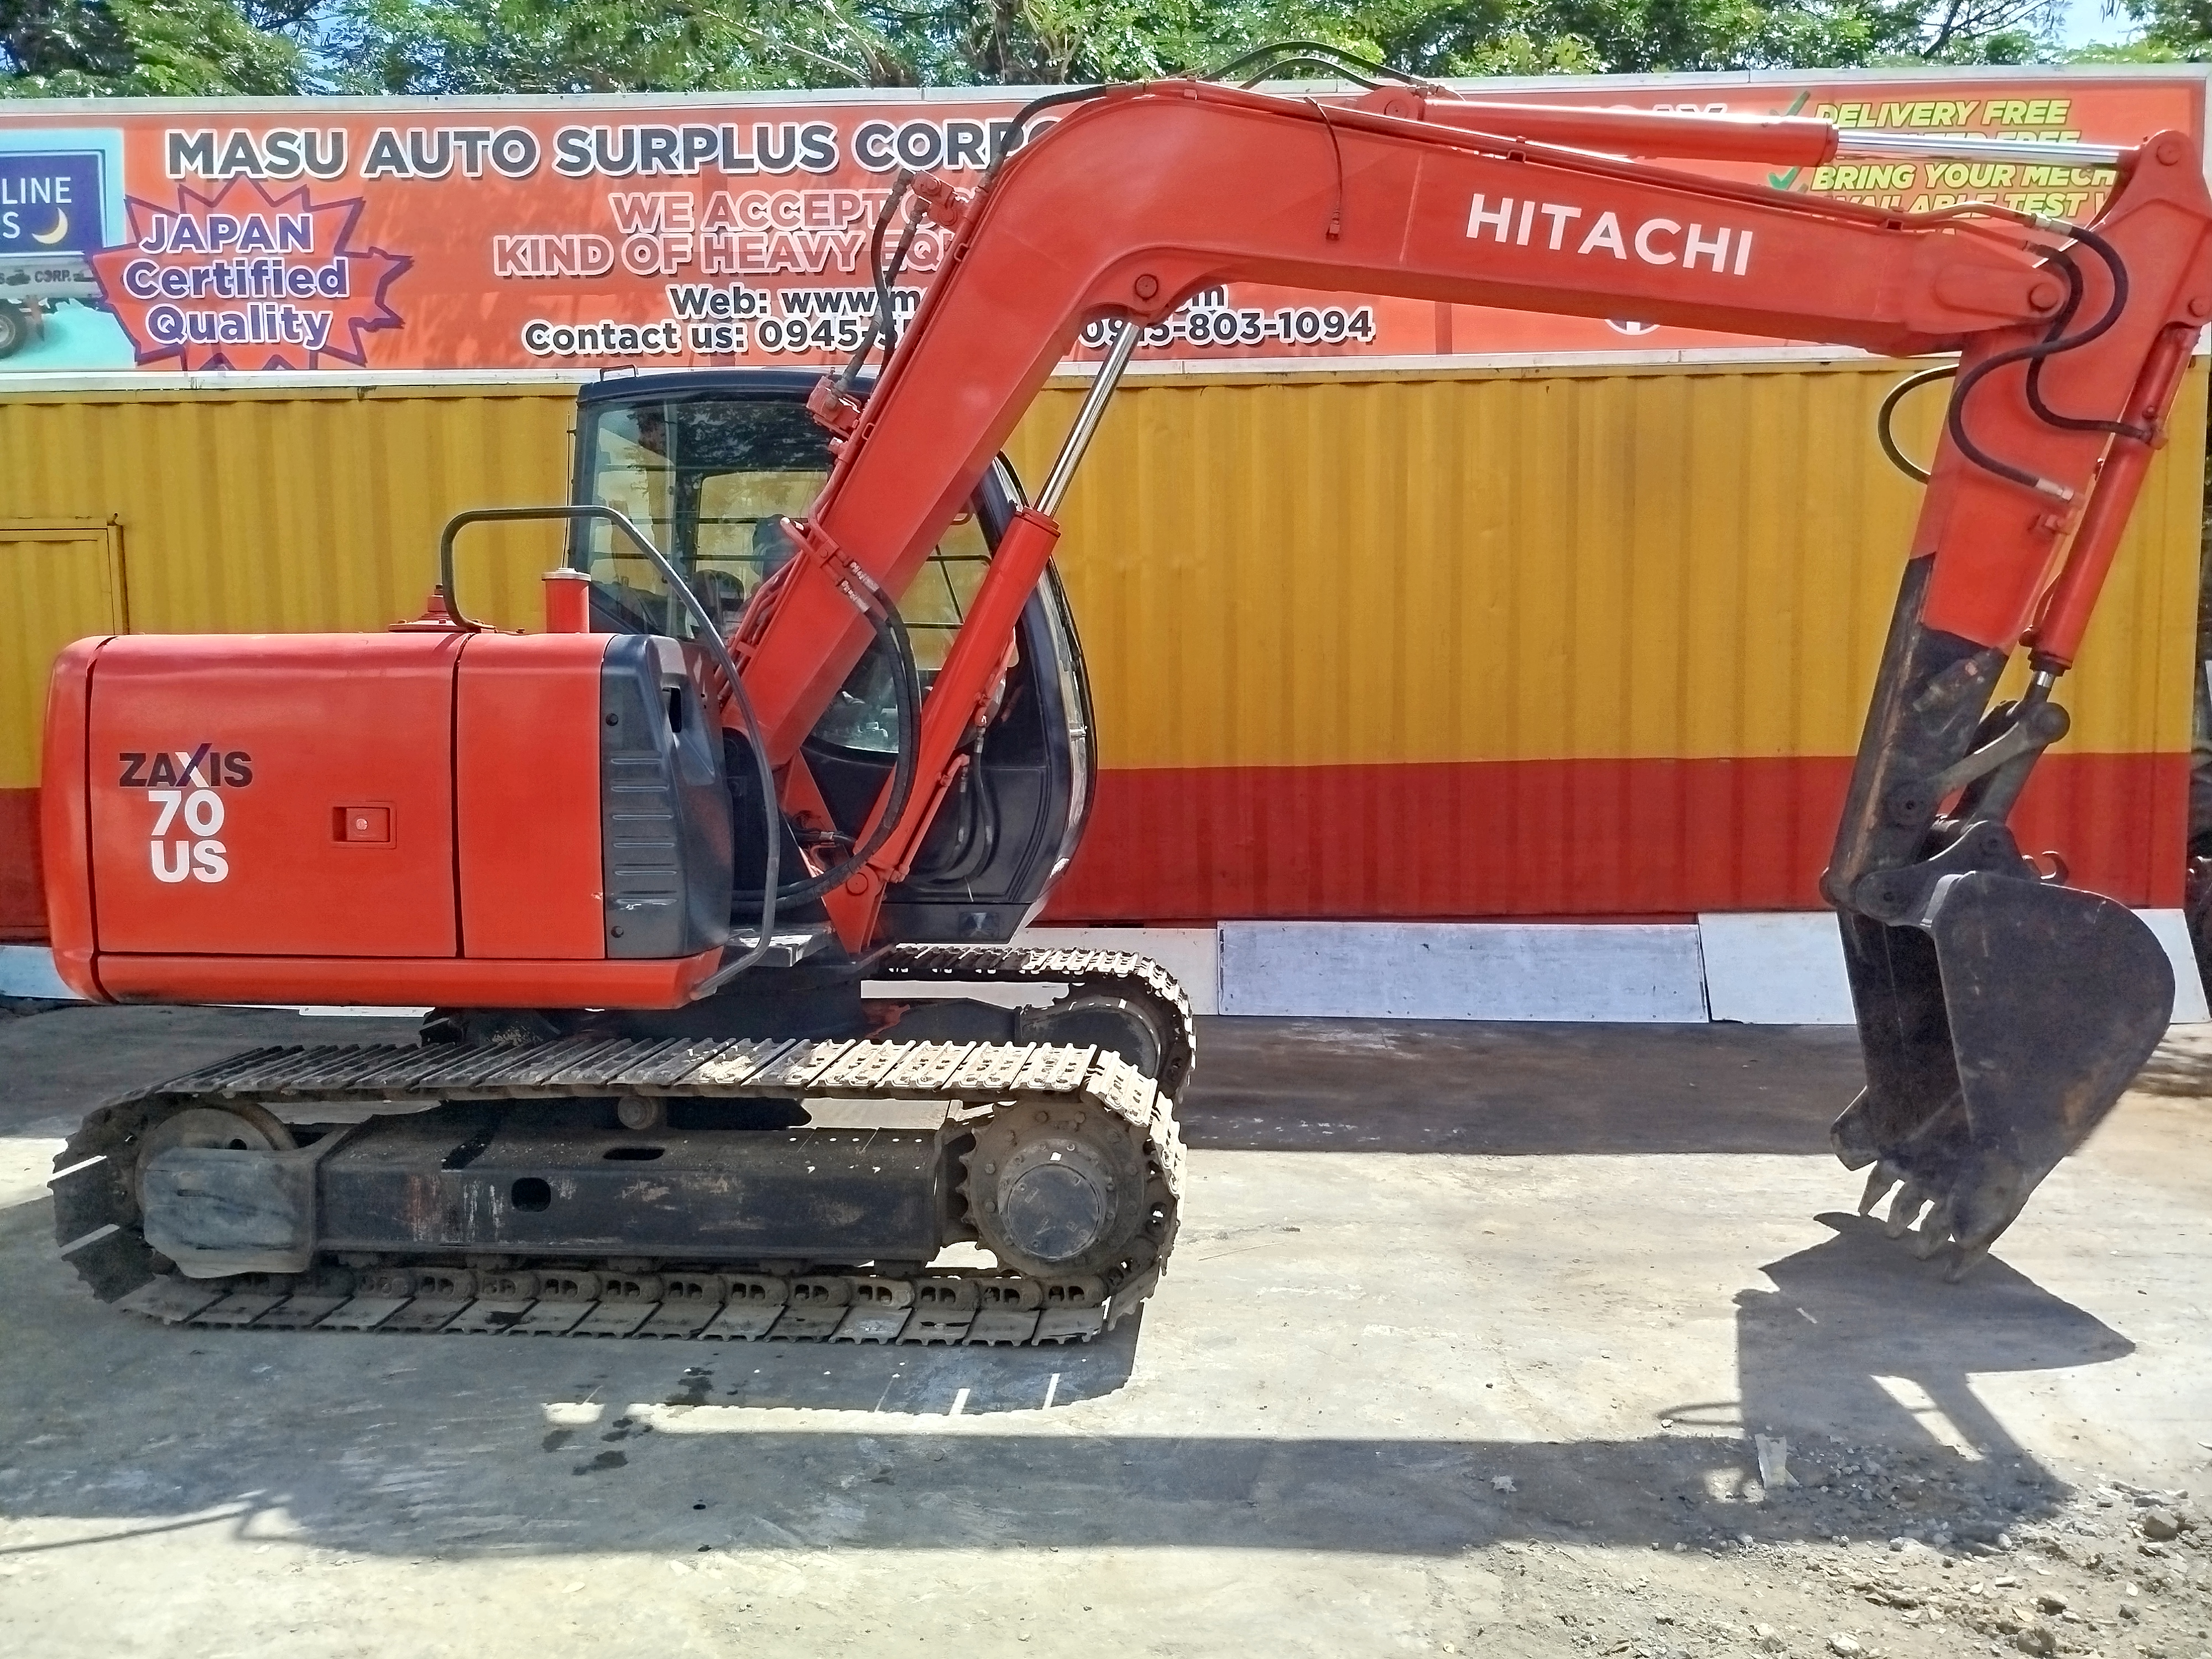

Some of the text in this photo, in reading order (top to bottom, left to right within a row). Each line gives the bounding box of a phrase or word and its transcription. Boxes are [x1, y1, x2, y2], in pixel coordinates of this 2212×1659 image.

[1815, 99, 2072, 129] DELIVERY FREE
[168, 129, 347, 177] MASU
[362, 128, 539, 178] AUTO
[555, 124, 838, 174] SURPLUS
[2, 176, 72, 205] LINE
[1811, 164, 1917, 191] BRING
[1924, 162, 2017, 189] YOUR
[2, 211, 20, 239] S
[610, 194, 694, 233] WE
[702, 191, 893, 232] ACCEPT
[2004, 192, 2089, 218] TEST
[141, 213, 313, 253] JAPAN
[495, 236, 613, 275] KIND
[622, 234, 693, 273] OF
[703, 232, 864, 272] HEAVY
[1466, 192, 1753, 276] HITACHI
[124, 256, 350, 299] Certified
[668, 286, 769, 316] Web:
[145, 301, 333, 349] Quality
[525, 322, 679, 352] Contact
[691, 325, 746, 351] us:
[119, 743, 253, 788] ZAXIS
[148, 789, 225, 837] 70
[150, 840, 229, 883] US
